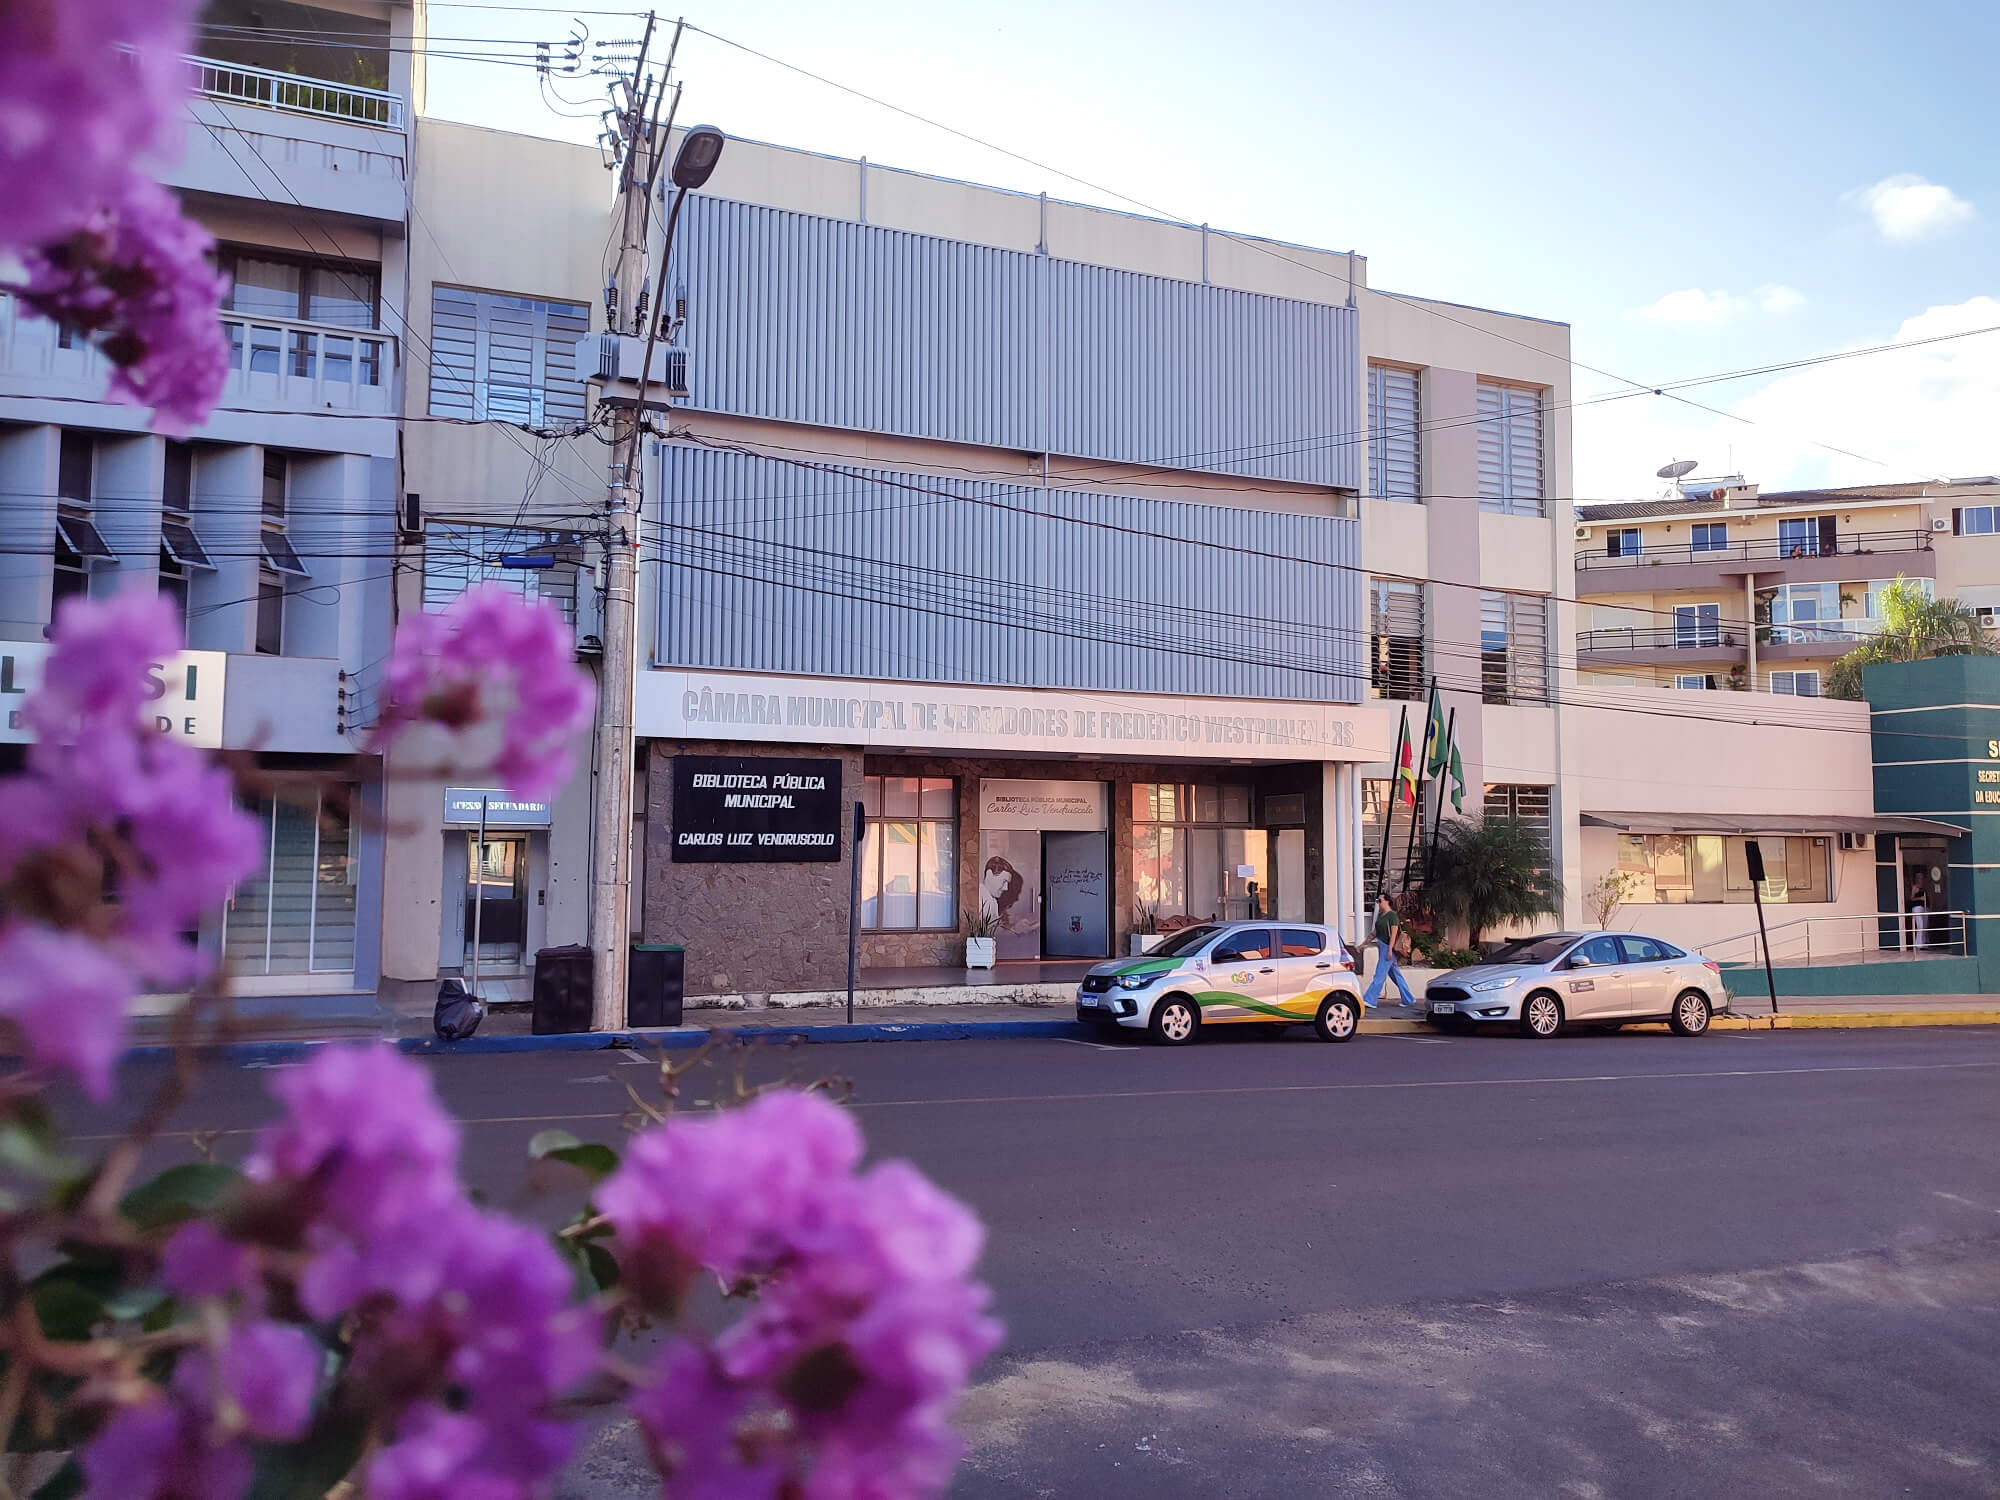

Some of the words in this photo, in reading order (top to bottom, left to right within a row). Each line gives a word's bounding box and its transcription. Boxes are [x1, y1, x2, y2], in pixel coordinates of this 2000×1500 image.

[682, 685, 782, 725] CÂMARA
[787, 696, 906, 730] MUNICIPAL
[911, 702, 937, 730] DE
[1073, 710, 1096, 738] DE
[1100, 711, 1200, 742] FREDERICO
[1988, 740, 2000, 758] S
[692, 773, 768, 789] BIBLIOTECA
[772, 772, 826, 790] PÚBLICA
[724, 794, 796, 809] MUNICIPAL
[1975, 790, 1985, 803] DA
[986, 802, 1017, 814] Carlos
[678, 833, 724, 846] CARLOS
[727, 833, 754, 846] LUIZ
[757, 833, 835, 846] VENDRUSCOLO
